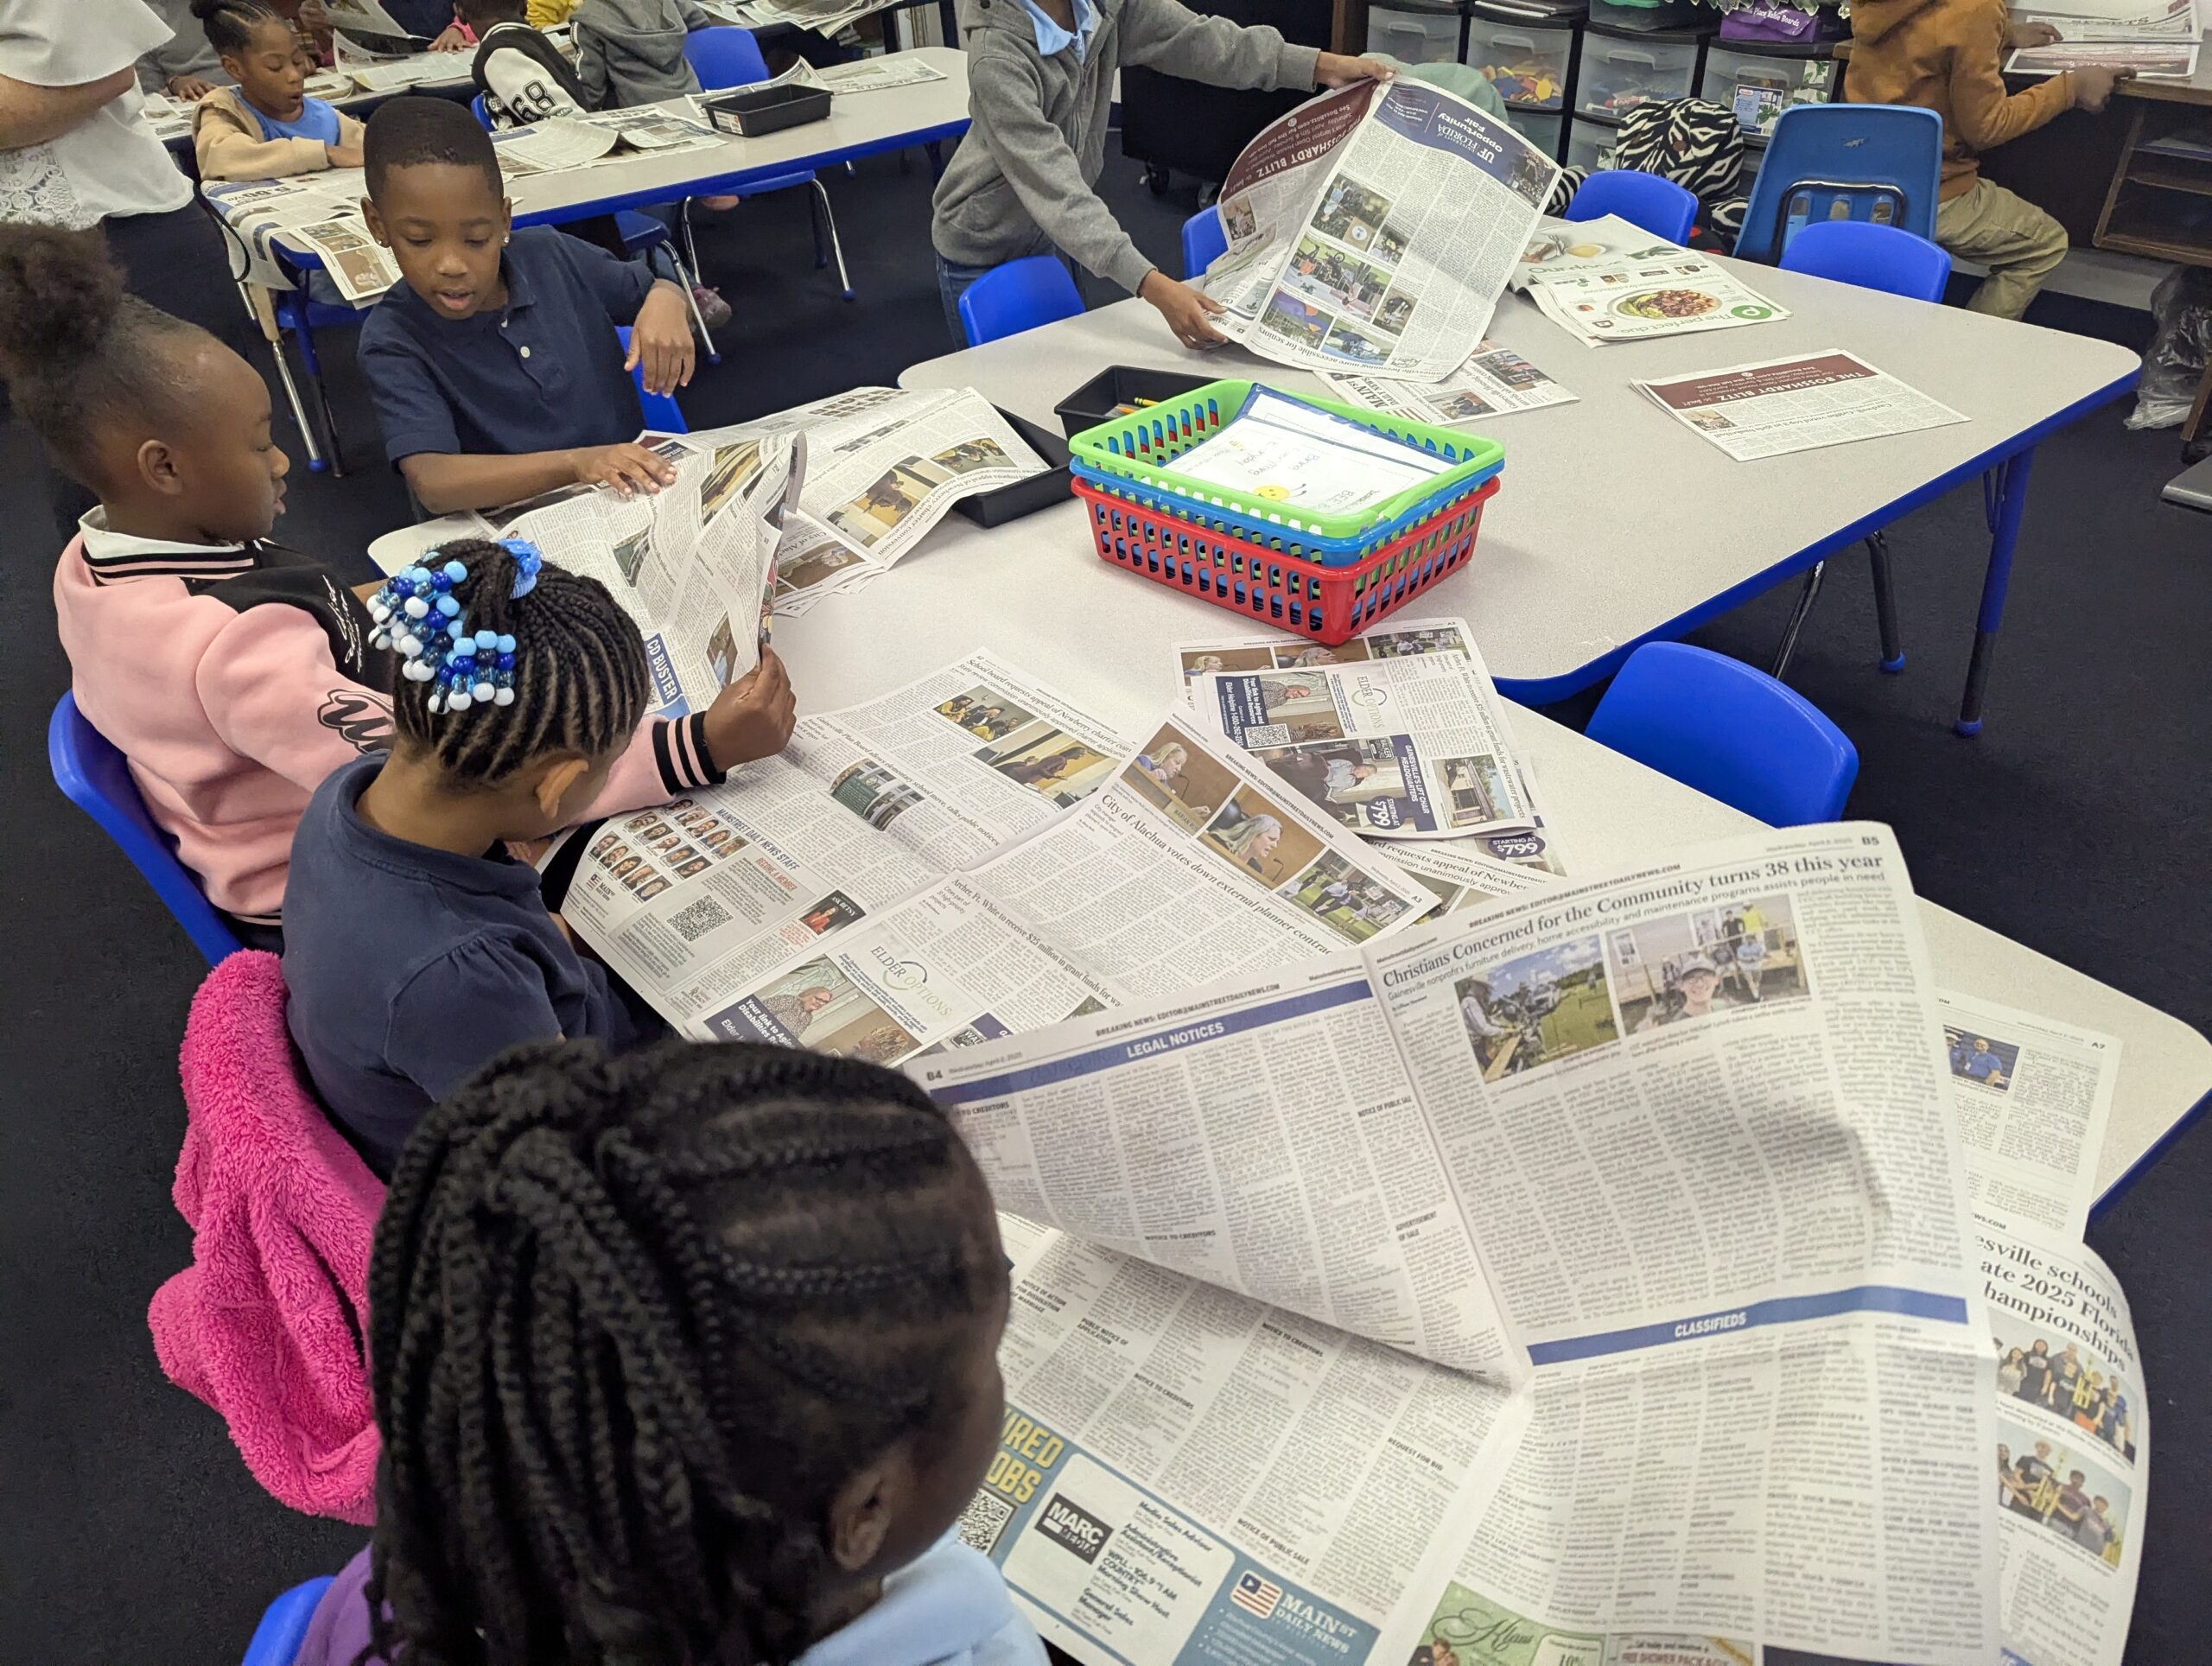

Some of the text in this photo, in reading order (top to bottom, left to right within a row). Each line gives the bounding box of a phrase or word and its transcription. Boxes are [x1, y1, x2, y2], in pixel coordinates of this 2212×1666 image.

[1752, 7, 1767, 18] Place
[1781, 15, 1800, 27] Boards
[510, 79, 558, 122] 68
[1435, 123, 1478, 149] FLORIDA
[1437, 111, 1503, 153] Opportunity
[1463, 115, 1485, 132] Fair
[1443, 134, 1474, 152] UNIVERSITY
[1476, 145, 1497, 163] UF
[1255, 157, 1287, 177] BLITZ
[1256, 326, 1284, 345] seniors
[1615, 311, 1732, 335] The perfect duo.
[1283, 340, 1296, 351] for
[1297, 346, 1338, 362] accessible
[1354, 382, 1389, 409] MAIN
[1359, 375, 1399, 405] DAILY NEWS
[1716, 371, 1864, 401] THE BOSSHARDT BLITZ
[885, 495, 931, 540] charter application
[911, 504, 932, 527] charter
[877, 525, 912, 556] conversion
[645, 638, 677, 699] CD BUSTER
[966, 658, 1116, 745] School board requests appeal Newberry charter
[1227, 693, 1237, 711] Helpline
[1243, 678, 1257, 723] Disabilities Resources
[1253, 702, 1262, 715] Aging
[1357, 676, 1383, 728] ELDER OPTIONS
[1379, 738, 1392, 758] WALKER
[1400, 756, 1418, 802] HEADQUARTERS
[1405, 745, 1429, 813] GAINESVILLE'S LIFT CHAIR
[911, 779, 1001, 847] school public notices
[1370, 800, 1390, 827] $799
[1386, 798, 1397, 817] STARTING
[1511, 794, 1528, 820] projects
[715, 808, 800, 872] MAINSTREET DAILY NEWS STAFF
[1497, 843, 1537, 853] $799
[754, 856, 798, 892] BECOME MEMBER
[1100, 793, 1122, 816] City
[1119, 809, 1135, 823] of
[1130, 817, 1170, 849] Alachua
[1166, 845, 1192, 867] votes
[1189, 861, 1219, 883] down
[1215, 878, 1259, 909] external
[1252, 902, 1294, 932] planner
[1387, 843, 1483, 877] requests appeal of
[1420, 863, 1478, 887] unanimously
[598, 881, 613, 894] MAIN
[839, 901, 856, 917] BETSY
[1382, 946, 1452, 989] Christians
[1451, 917, 1535, 963] Concerned
[1535, 908, 1562, 932] for
[1564, 902, 1592, 923] the
[1596, 876, 1704, 914] Community
[1708, 867, 1760, 888] turns
[1764, 860, 1789, 878] 38
[1794, 855, 1832, 874] this
[1838, 854, 1883, 873] year
[951, 877, 1113, 1001] Archer, White receive $25 million in grant funds for
[1387, 870, 1885, 1002] Gainesville nonprofit's furniture delivery, home accessibility and maintenance programs assists people need
[870, 944, 951, 1017] ELDER OPTIONS
[721, 1018, 740, 1038] Elder
[737, 1002, 771, 1038] Disabilities
[745, 998, 779, 1033] Your link to
[1126, 1021, 1225, 1059] LEGAL NOTICES
[2019, 1270, 2077, 1312] 2025
[2046, 1264, 2119, 1318] schools
[1674, 1312, 1747, 1339] CLASSIFIEDS
[1046, 1499, 1105, 1547] MARC
[1138, 1500, 1213, 1553] Media Sales Advisor
[1119, 1528, 1203, 1587] Assistant/Receptionist
[1124, 1522, 1179, 1562] Administrative
[1077, 1595, 1113, 1623] Manager
[1082, 1587, 1135, 1626] General Sales
[1096, 1565, 1171, 1618] Morning Show Host
[1274, 1607, 1313, 1634] DAILY
[1312, 1627, 1351, 1655] NEWS
[1280, 1592, 1342, 1635] MAIN
